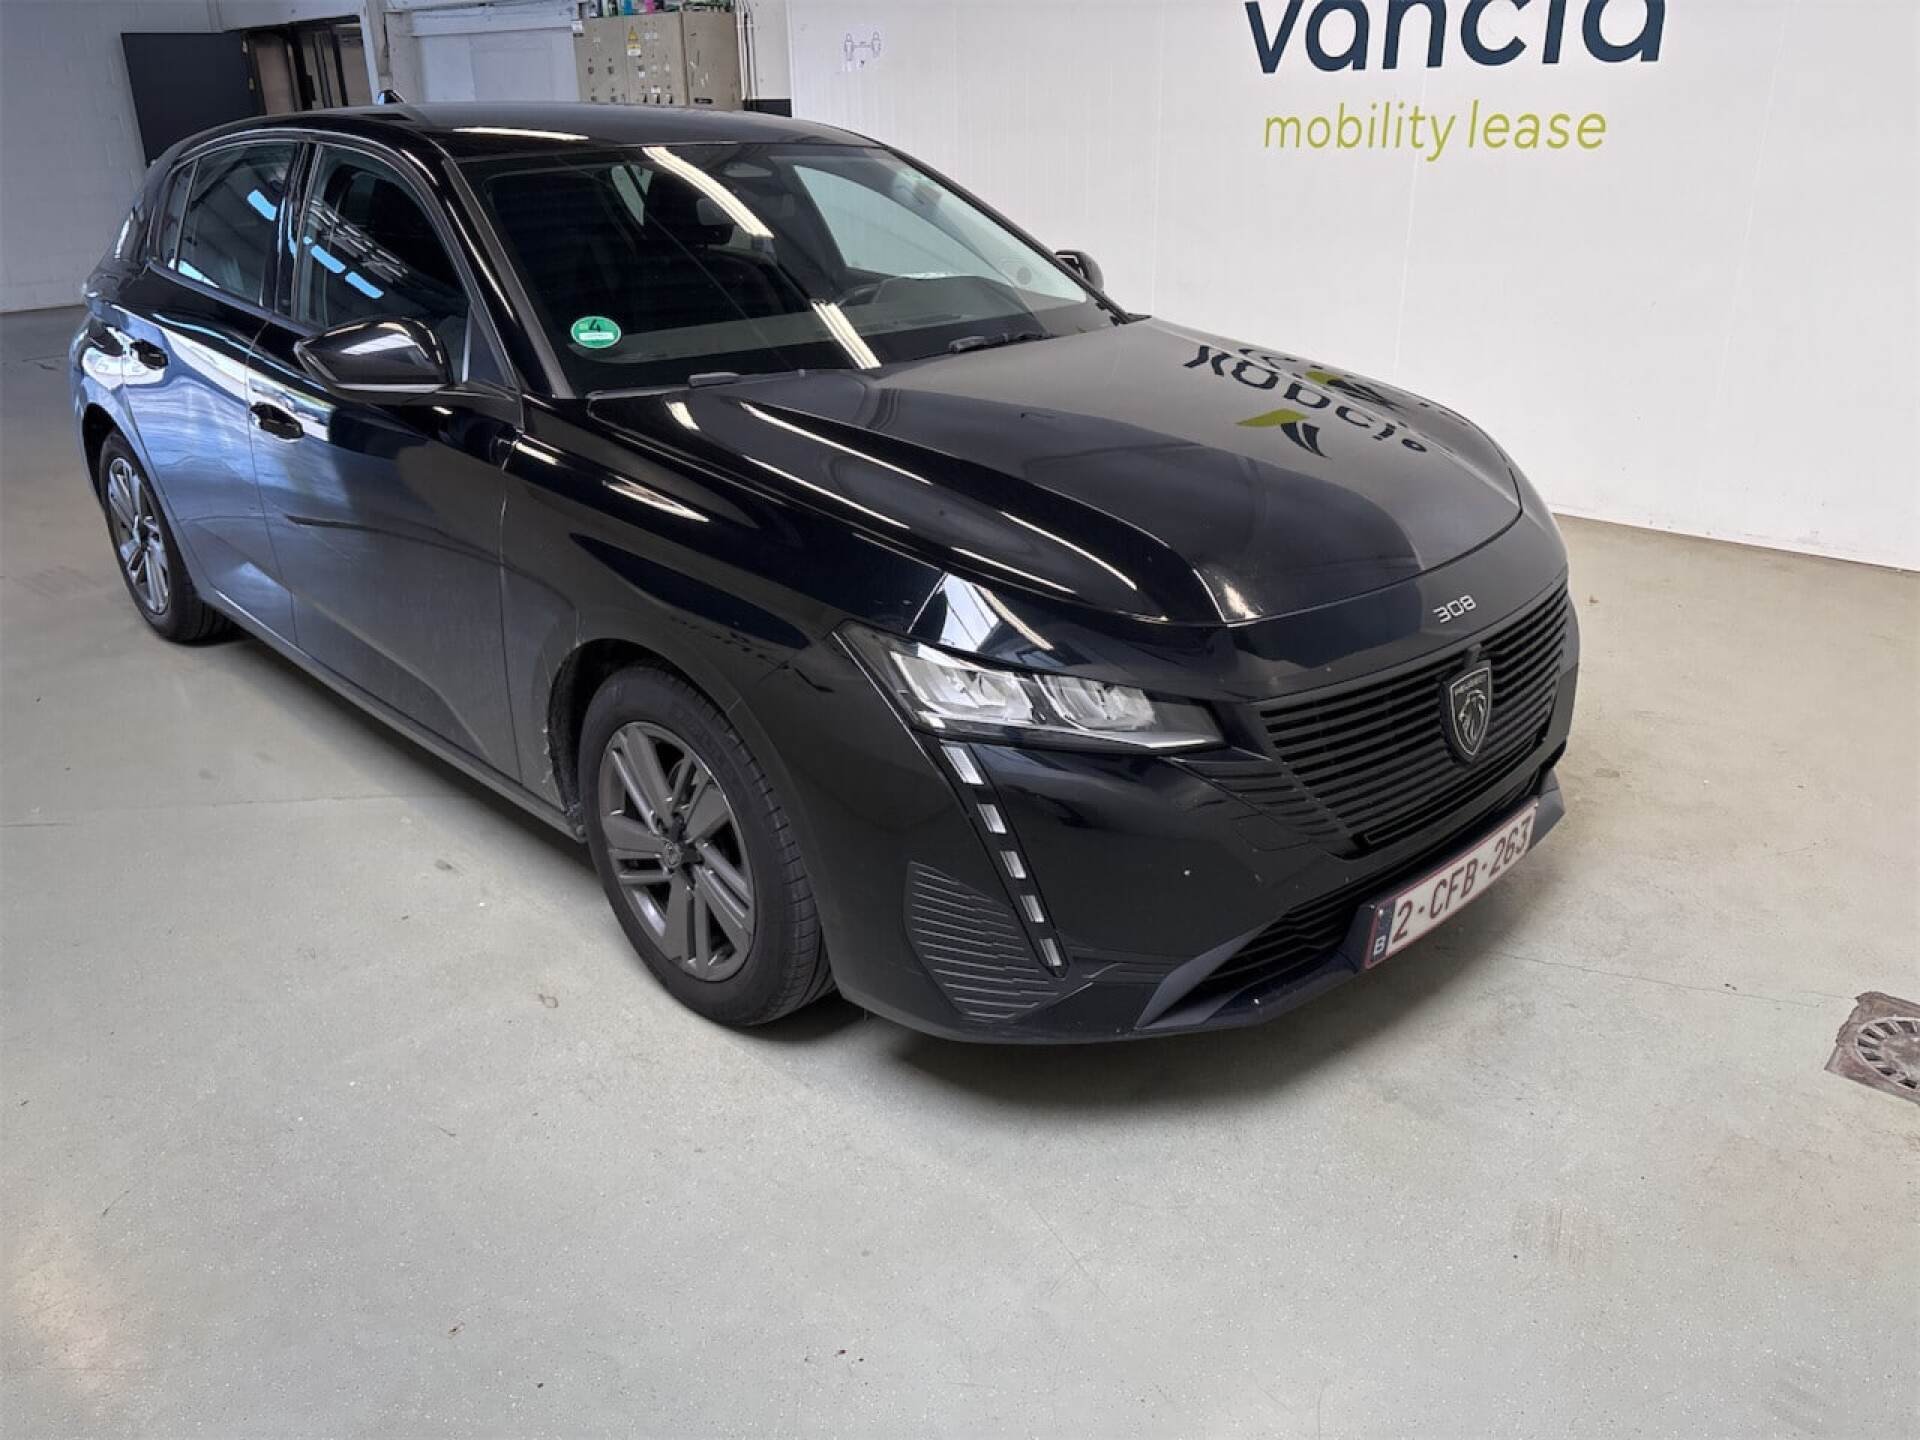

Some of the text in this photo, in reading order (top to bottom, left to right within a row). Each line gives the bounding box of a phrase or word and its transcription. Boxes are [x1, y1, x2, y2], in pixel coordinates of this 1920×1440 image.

[1264, 100, 1607, 162] mobility lease
[1432, 594, 1477, 624] 308
